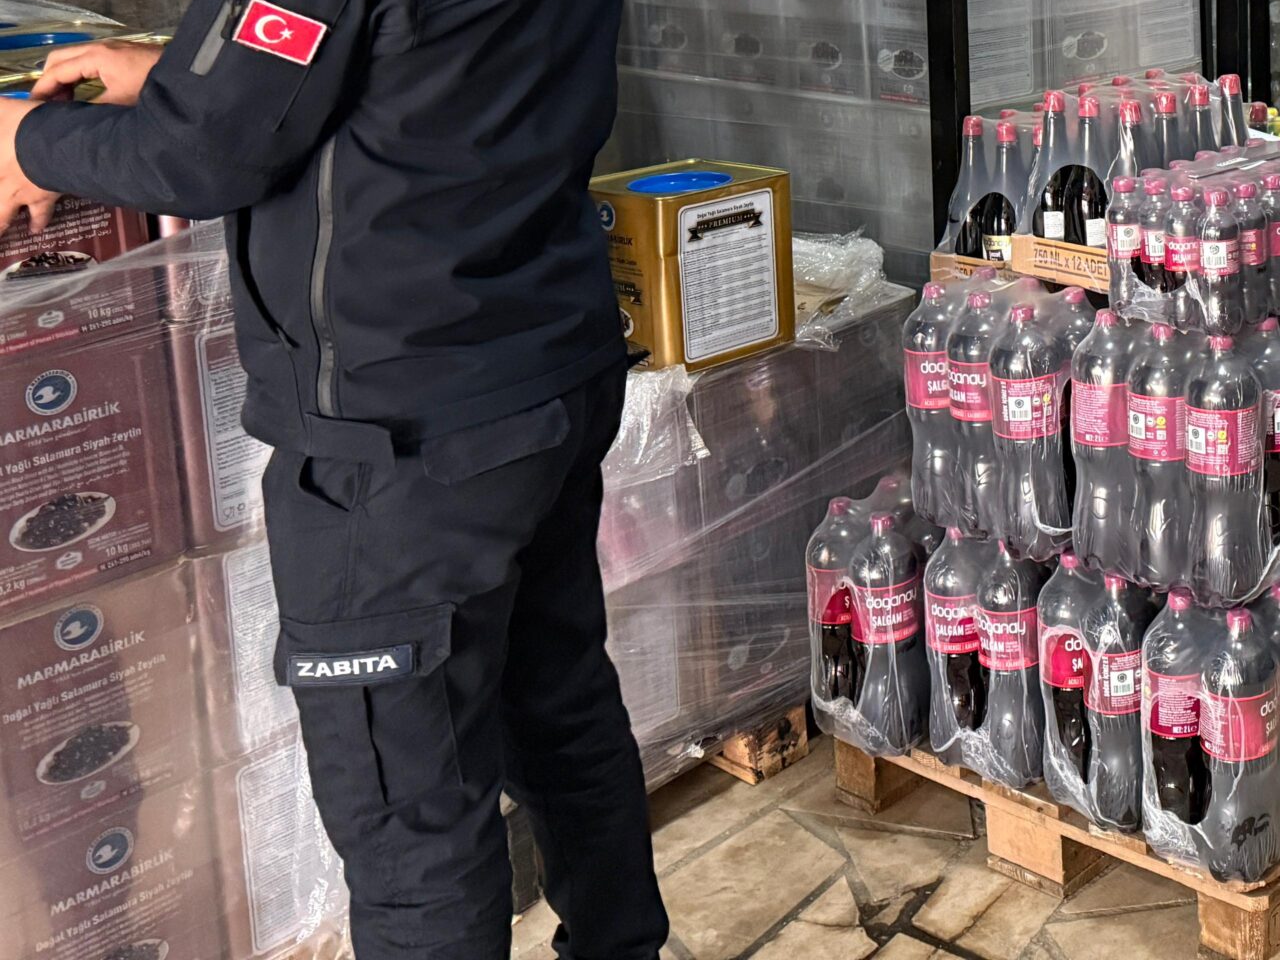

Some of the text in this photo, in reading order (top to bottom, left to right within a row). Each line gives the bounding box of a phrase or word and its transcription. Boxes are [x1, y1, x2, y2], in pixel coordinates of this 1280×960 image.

[709, 215, 743, 228] PREMIUM
[1073, 254, 1082, 271] 12
[100, 307, 112, 319] kg
[0, 401, 121, 447] ARMARABİRLİK
[5, 462, 31, 475] Yağlı
[33, 445, 81, 467] Salamura
[83, 436, 111, 452] Siyah
[112, 427, 142, 443] Zeytin
[118, 543, 129, 556] kg
[872, 612, 903, 629] ŞALGAM
[17, 630, 146, 690] MARMARABİRLİK
[297, 654, 400, 678] ZABITA
[3, 654, 167, 725] Doğal Yağlı Salamura Siyah Zeytin
[50, 848, 173, 917] MARMARABİRLİK
[93, 898, 138, 925] Salamura
[139, 885, 165, 902] Siyah
